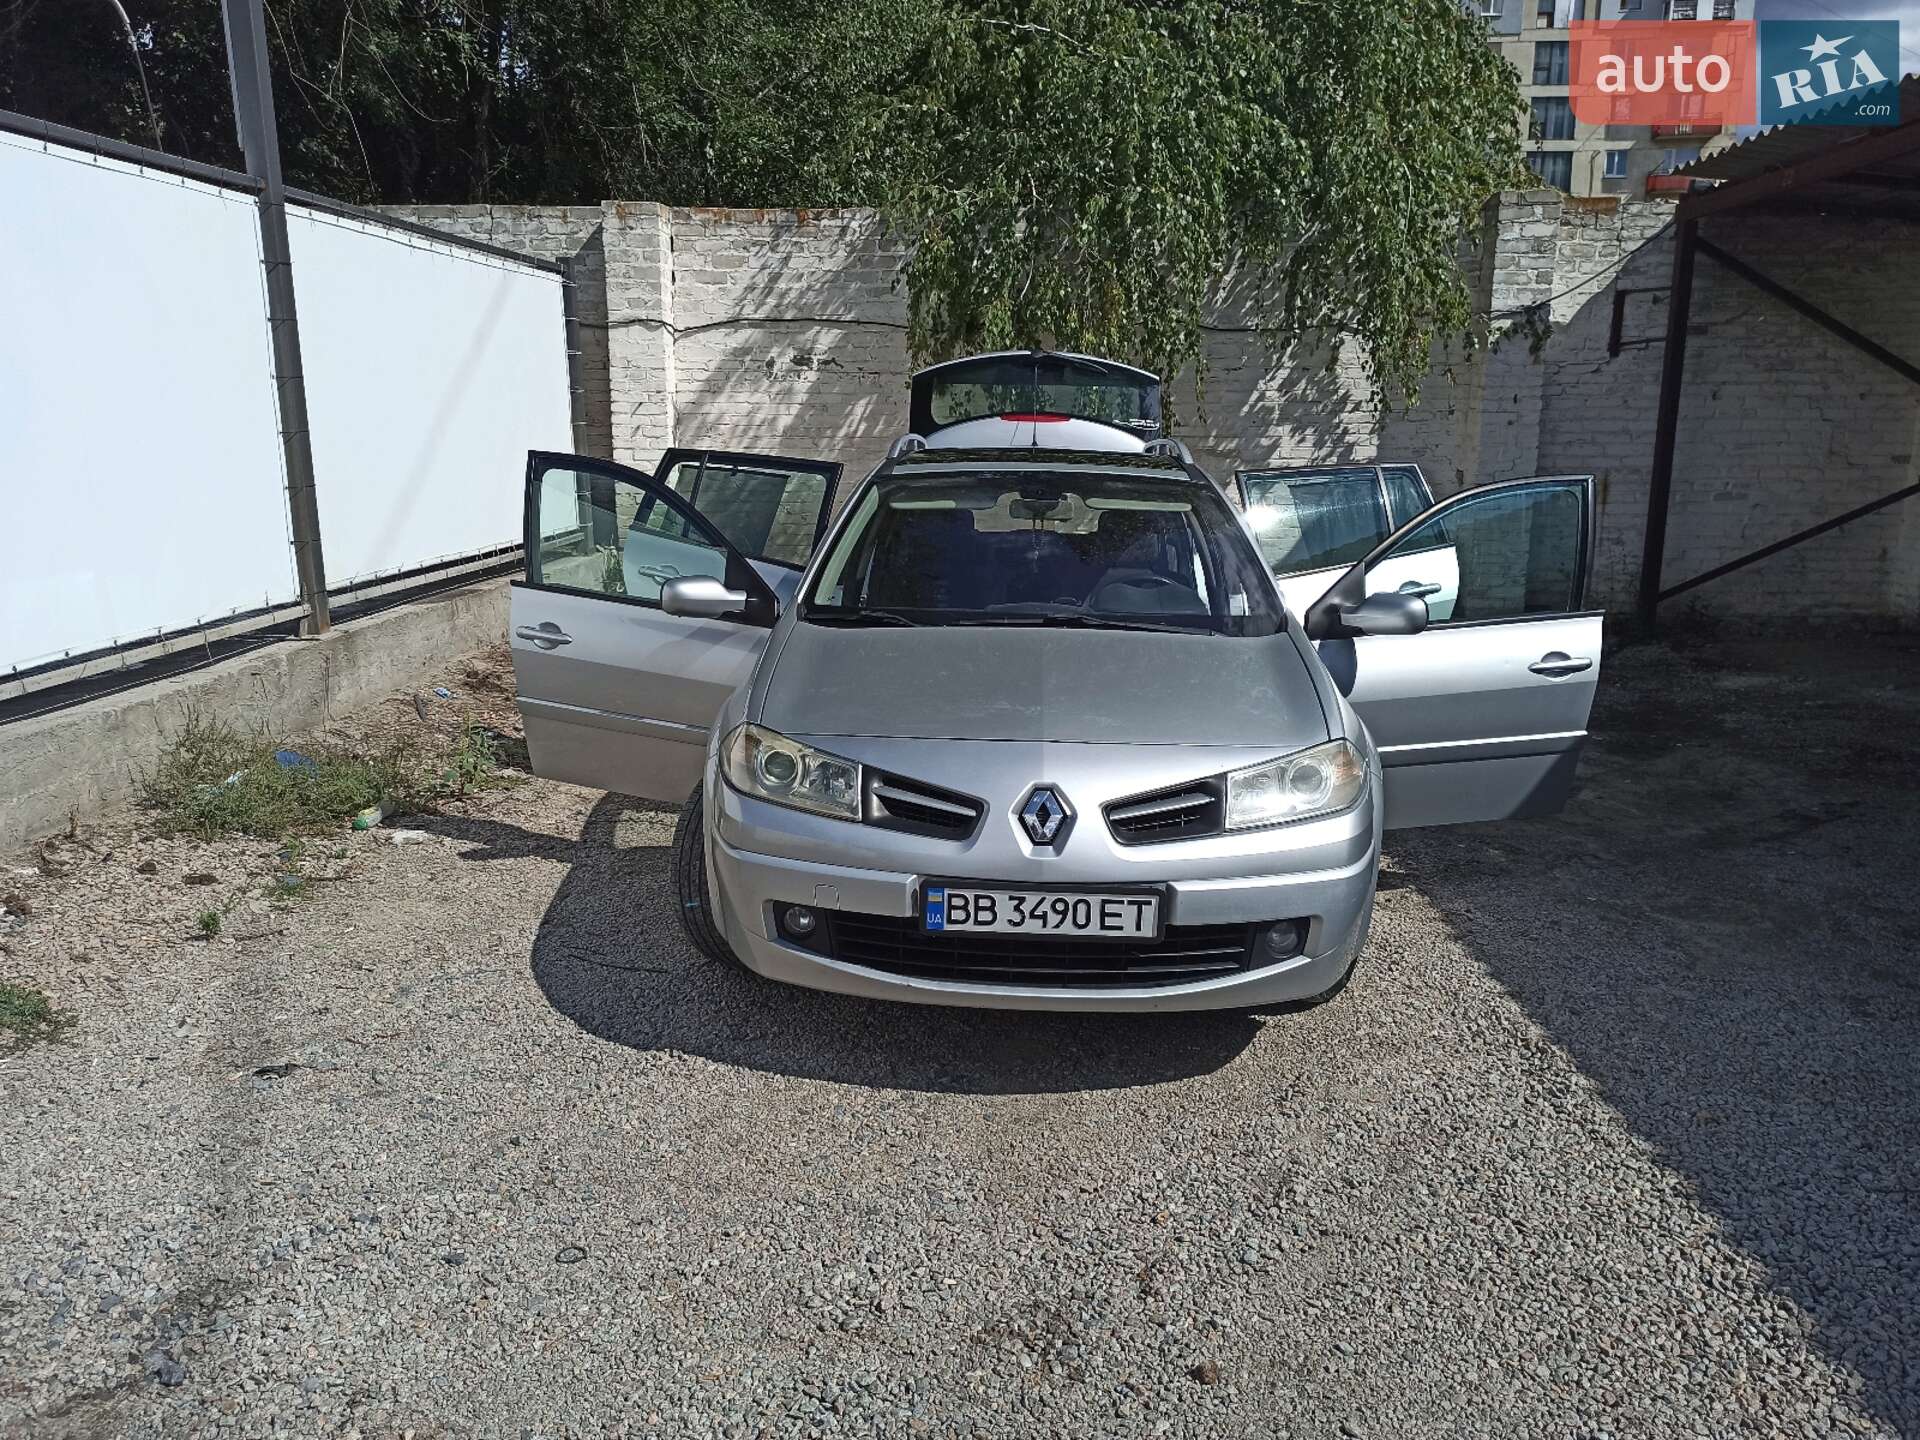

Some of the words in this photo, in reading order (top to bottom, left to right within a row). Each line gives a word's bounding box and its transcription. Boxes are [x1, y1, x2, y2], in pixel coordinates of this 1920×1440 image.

[927, 912, 942, 924] UA
[947, 893, 998, 926] BB
[1008, 895, 1092, 930] 3490
[1100, 899, 1153, 932] ET
